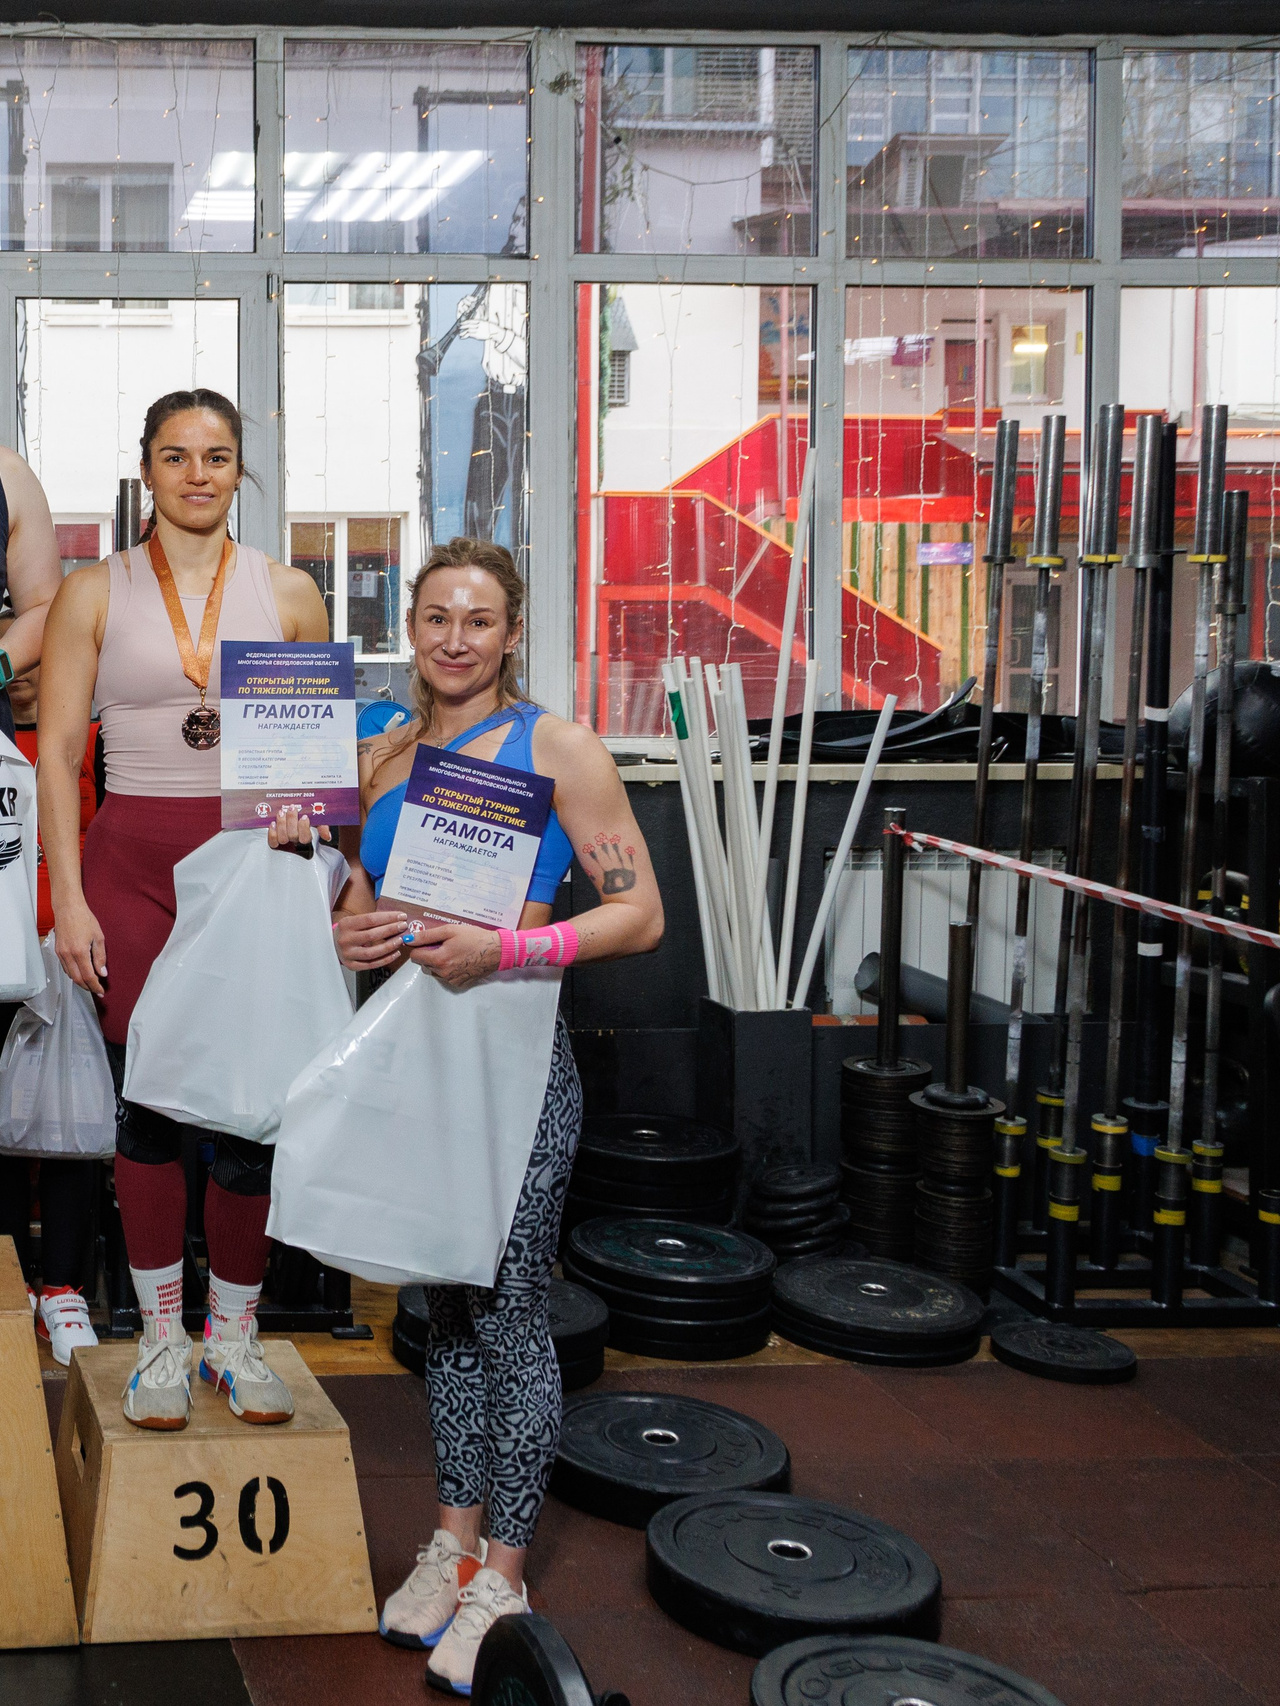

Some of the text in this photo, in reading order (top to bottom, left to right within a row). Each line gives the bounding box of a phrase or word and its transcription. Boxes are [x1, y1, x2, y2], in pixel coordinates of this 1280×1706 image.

[253, 686, 294, 695] ТЯЖЕЛОЙ
[242, 704, 334, 719] ГРАМОТА
[429, 766, 534, 798] МНОГОБОРЬЯ СВЕРДЛОВСКОЙ ОБЛАСТИ
[439, 761, 527, 788] ФЕДЕРАЦИЯ ФУНКЦИОНАЛЬНОГО
[422, 794, 526, 828] ПО ТЯЖЕЛОЙ АТЛЕТИКЕ
[434, 786, 520, 814] ОТКРЫТЫЙ ТУРНИР
[421, 813, 514, 851] ГРАМОТА
[433, 837, 498, 859] НАГРАЖДАЕТСЯ
[423, 911, 461, 924] ЕКАТЕРИНБУРГ
[173, 1476, 290, 1561] 30
